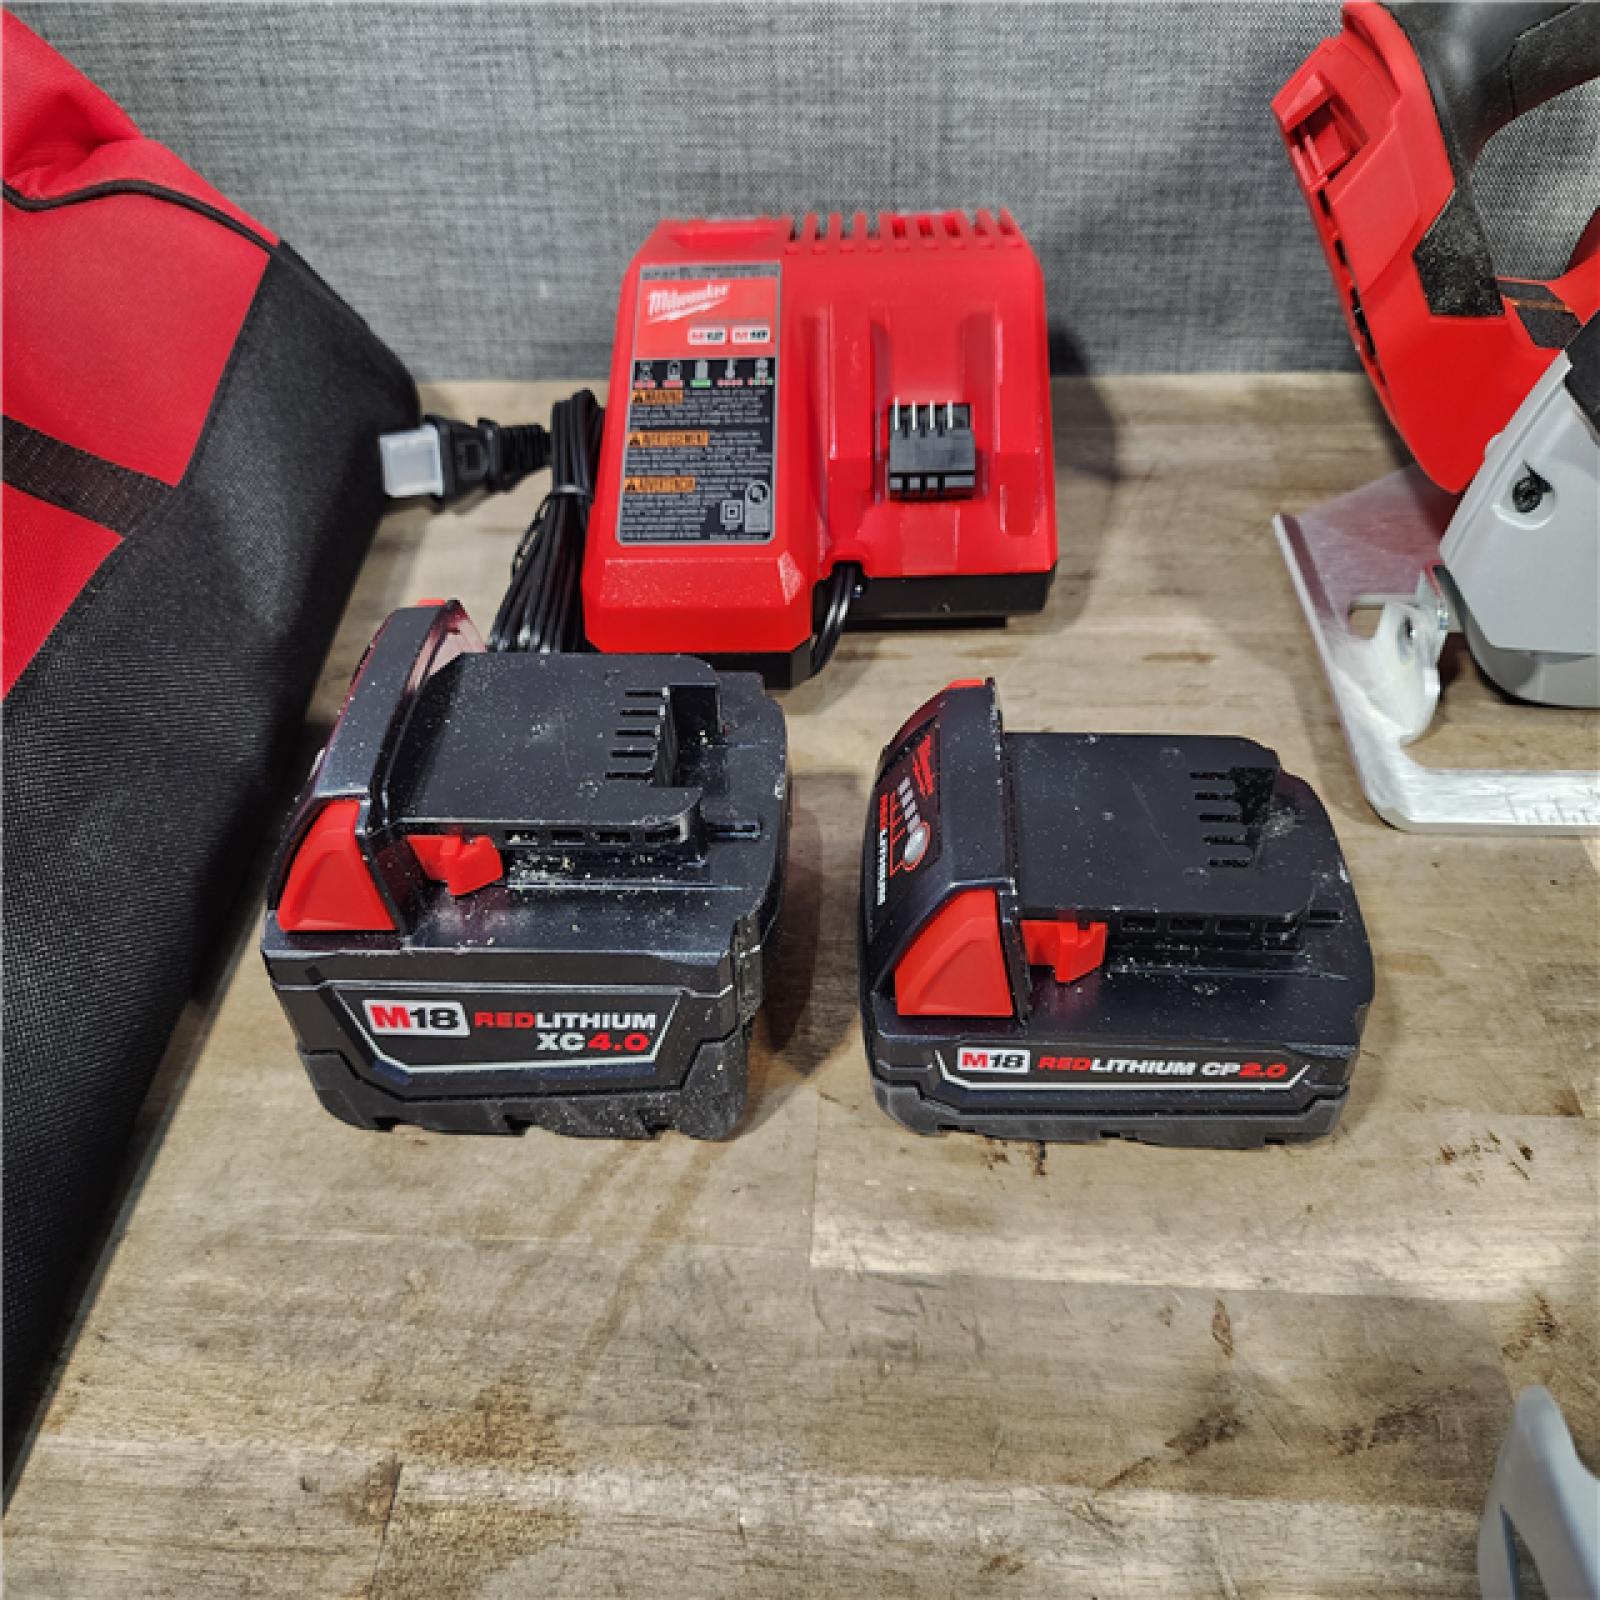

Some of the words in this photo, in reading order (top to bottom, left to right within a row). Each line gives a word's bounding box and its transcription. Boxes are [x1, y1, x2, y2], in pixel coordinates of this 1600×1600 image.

[369, 1004, 459, 1029] M18
[474, 1011, 656, 1029] REDLITHIUM
[961, 1051, 1024, 1069] M18
[1038, 1057, 1196, 1076] REDLITHIUM
[1201, 1062, 1288, 1078] CP2.0
